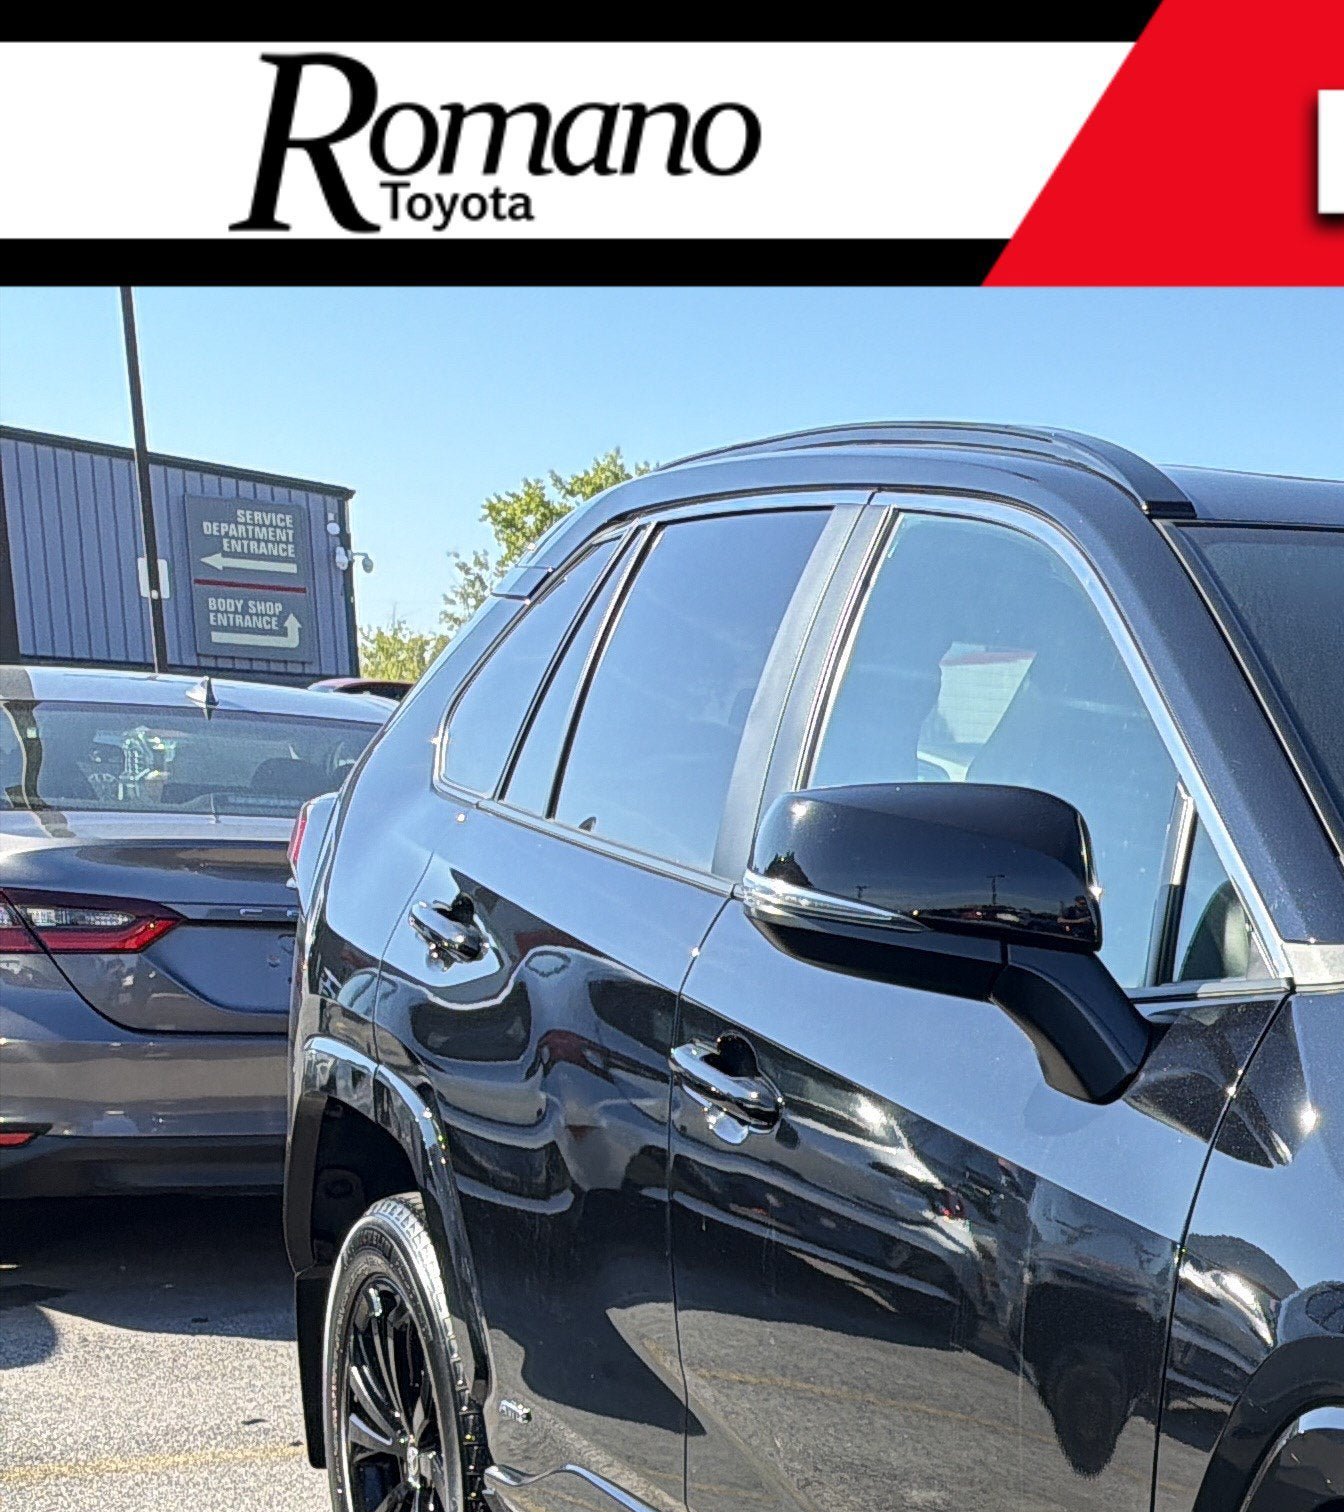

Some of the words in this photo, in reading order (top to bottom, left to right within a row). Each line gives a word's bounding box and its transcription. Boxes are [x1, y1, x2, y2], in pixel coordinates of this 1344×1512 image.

[236, 509, 294, 528] SERVICE
[203, 521, 294, 543] DEPARTMENT
[222, 538, 296, 558] ENTRANCE
[208, 597, 244, 612] BODY
[248, 600, 283, 616] SHOP
[209, 612, 279, 630] ENTRANCE
